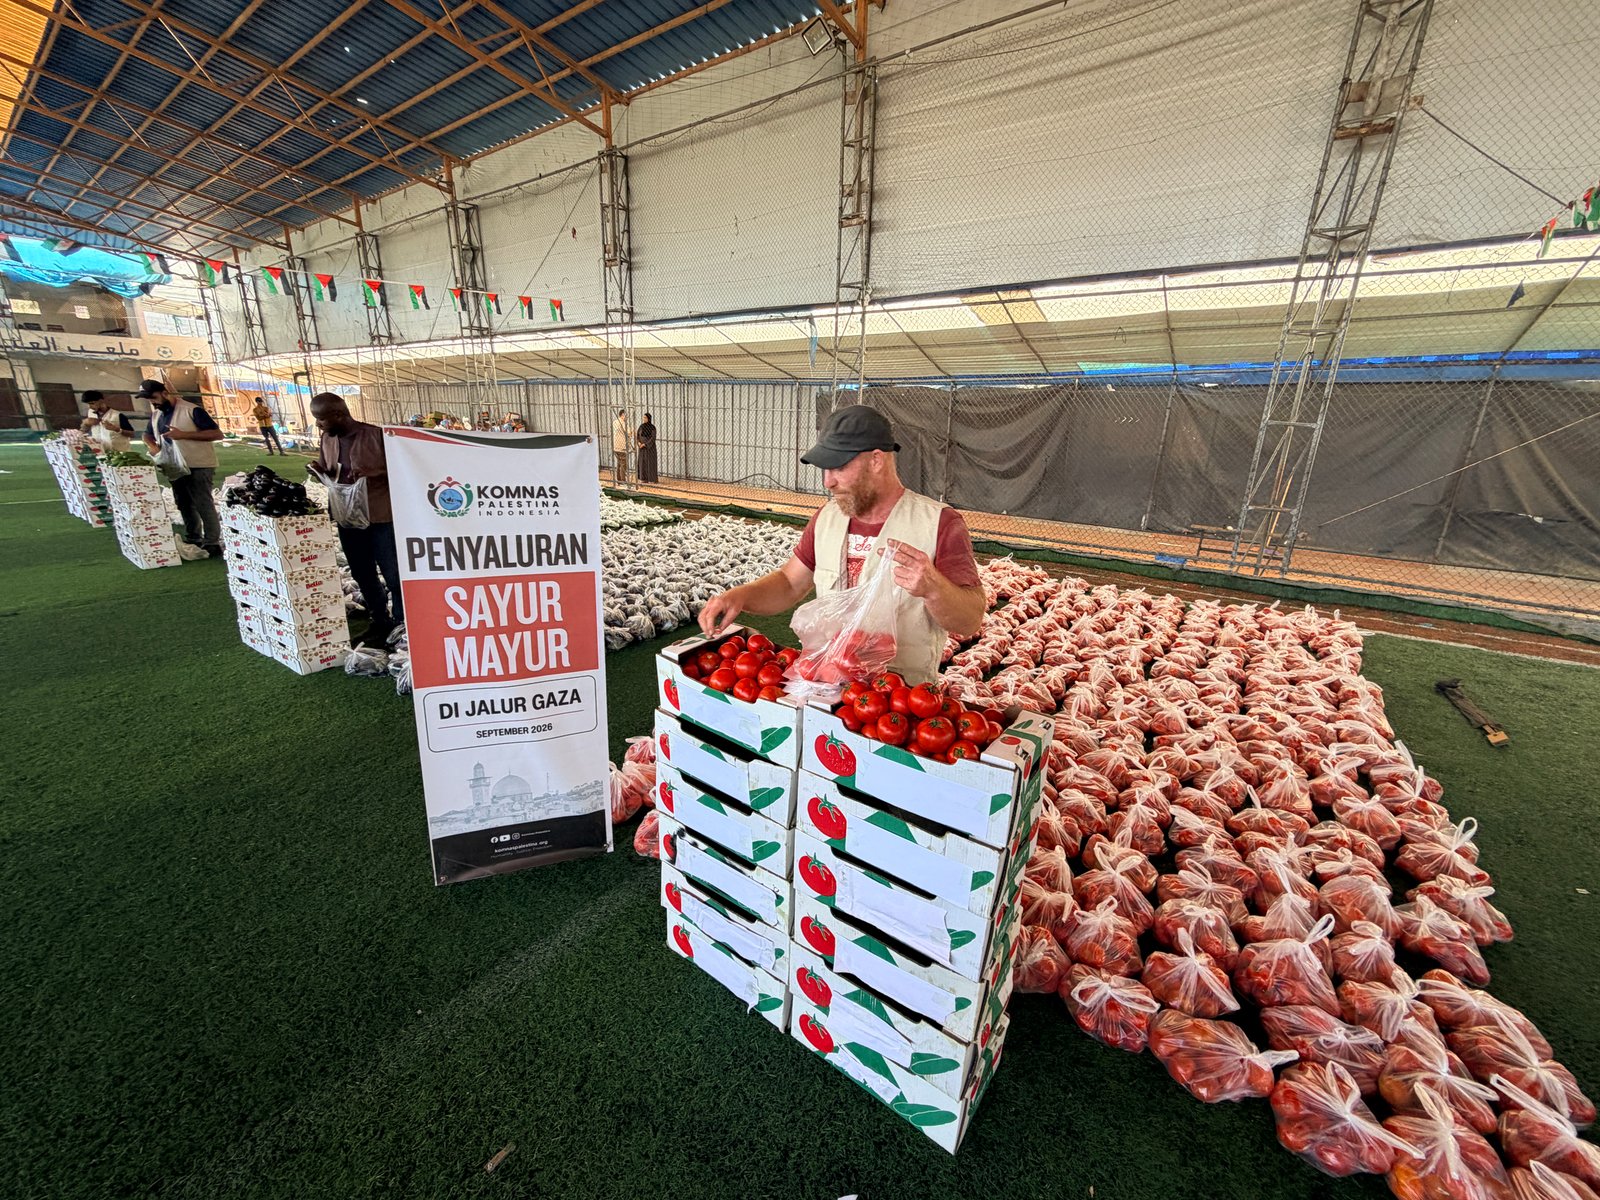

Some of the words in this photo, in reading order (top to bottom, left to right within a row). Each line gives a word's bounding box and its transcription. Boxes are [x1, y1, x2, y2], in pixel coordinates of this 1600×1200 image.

[477, 485, 559, 499] KOMNAS
[478, 500, 560, 508] PALESTINA
[406, 533, 588, 573] PENYALURAN
[444, 580, 563, 630] SAYUR
[444, 628, 570, 679] MAYUR
[439, 702, 459, 720] DI
[465, 697, 527, 717] JALUR
[532, 688, 582, 710] GAZA
[476, 726, 529, 738] SEPTEMBER
[531, 723, 553, 734] 2026
